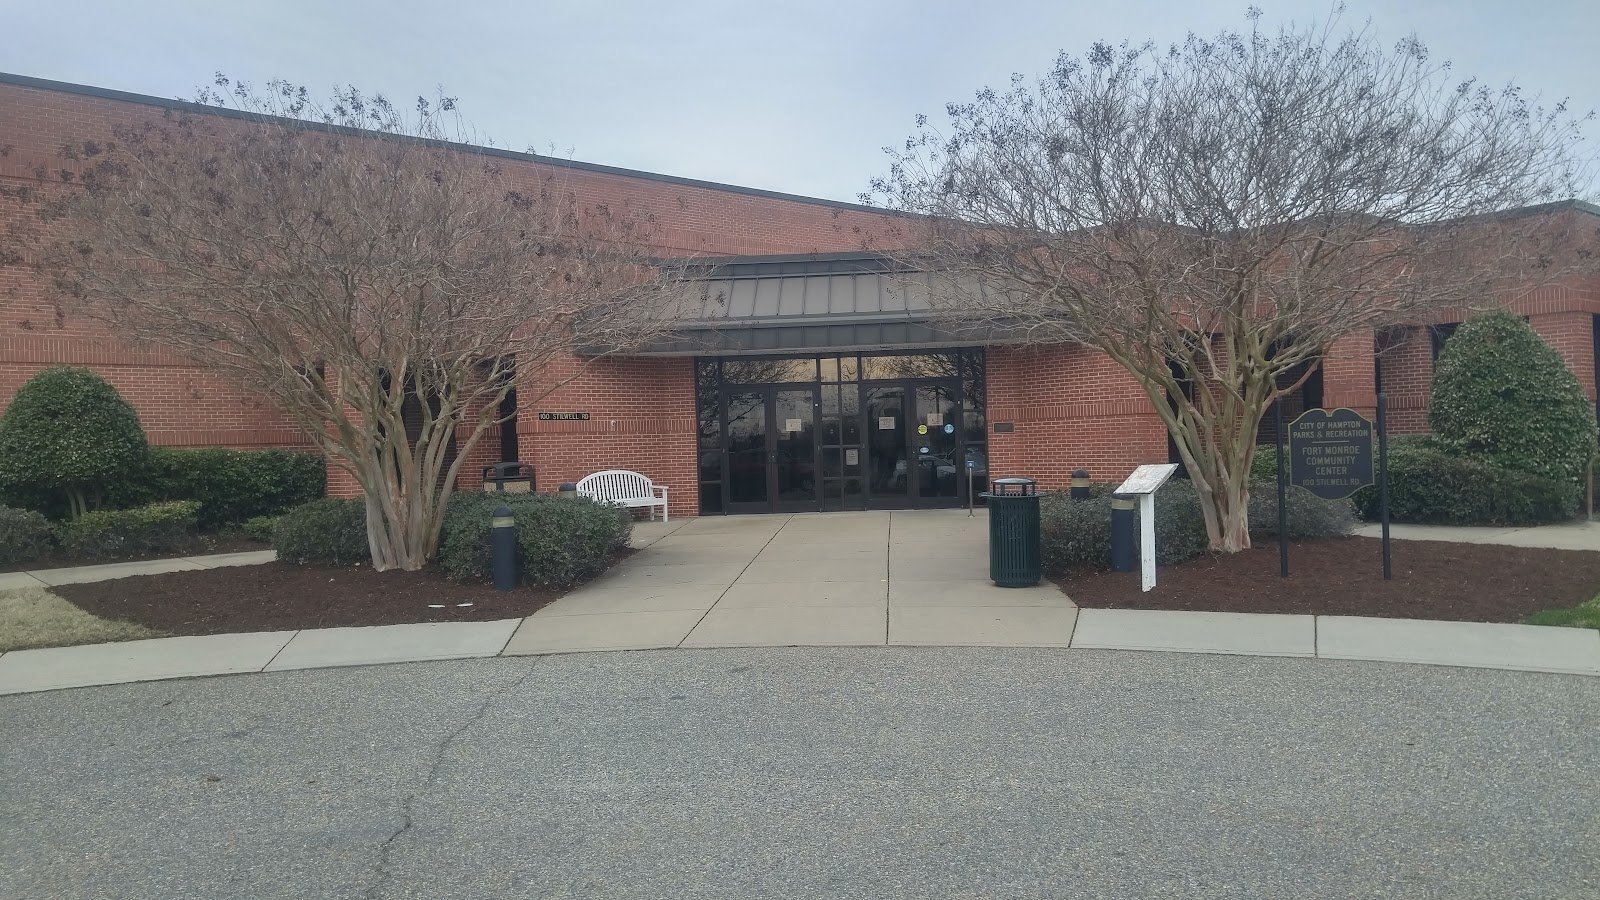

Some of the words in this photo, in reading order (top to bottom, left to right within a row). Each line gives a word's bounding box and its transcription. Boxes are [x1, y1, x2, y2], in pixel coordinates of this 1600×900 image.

[1328, 421, 1361, 429] HAMPTON
[1326, 430, 1368, 438] RECREATION
[1302, 447, 1322, 455] FORT
[1325, 446, 1360, 454] MONROE
[1306, 456, 1356, 465] COMMUNITY
[1316, 466, 1347, 475] CENTER
